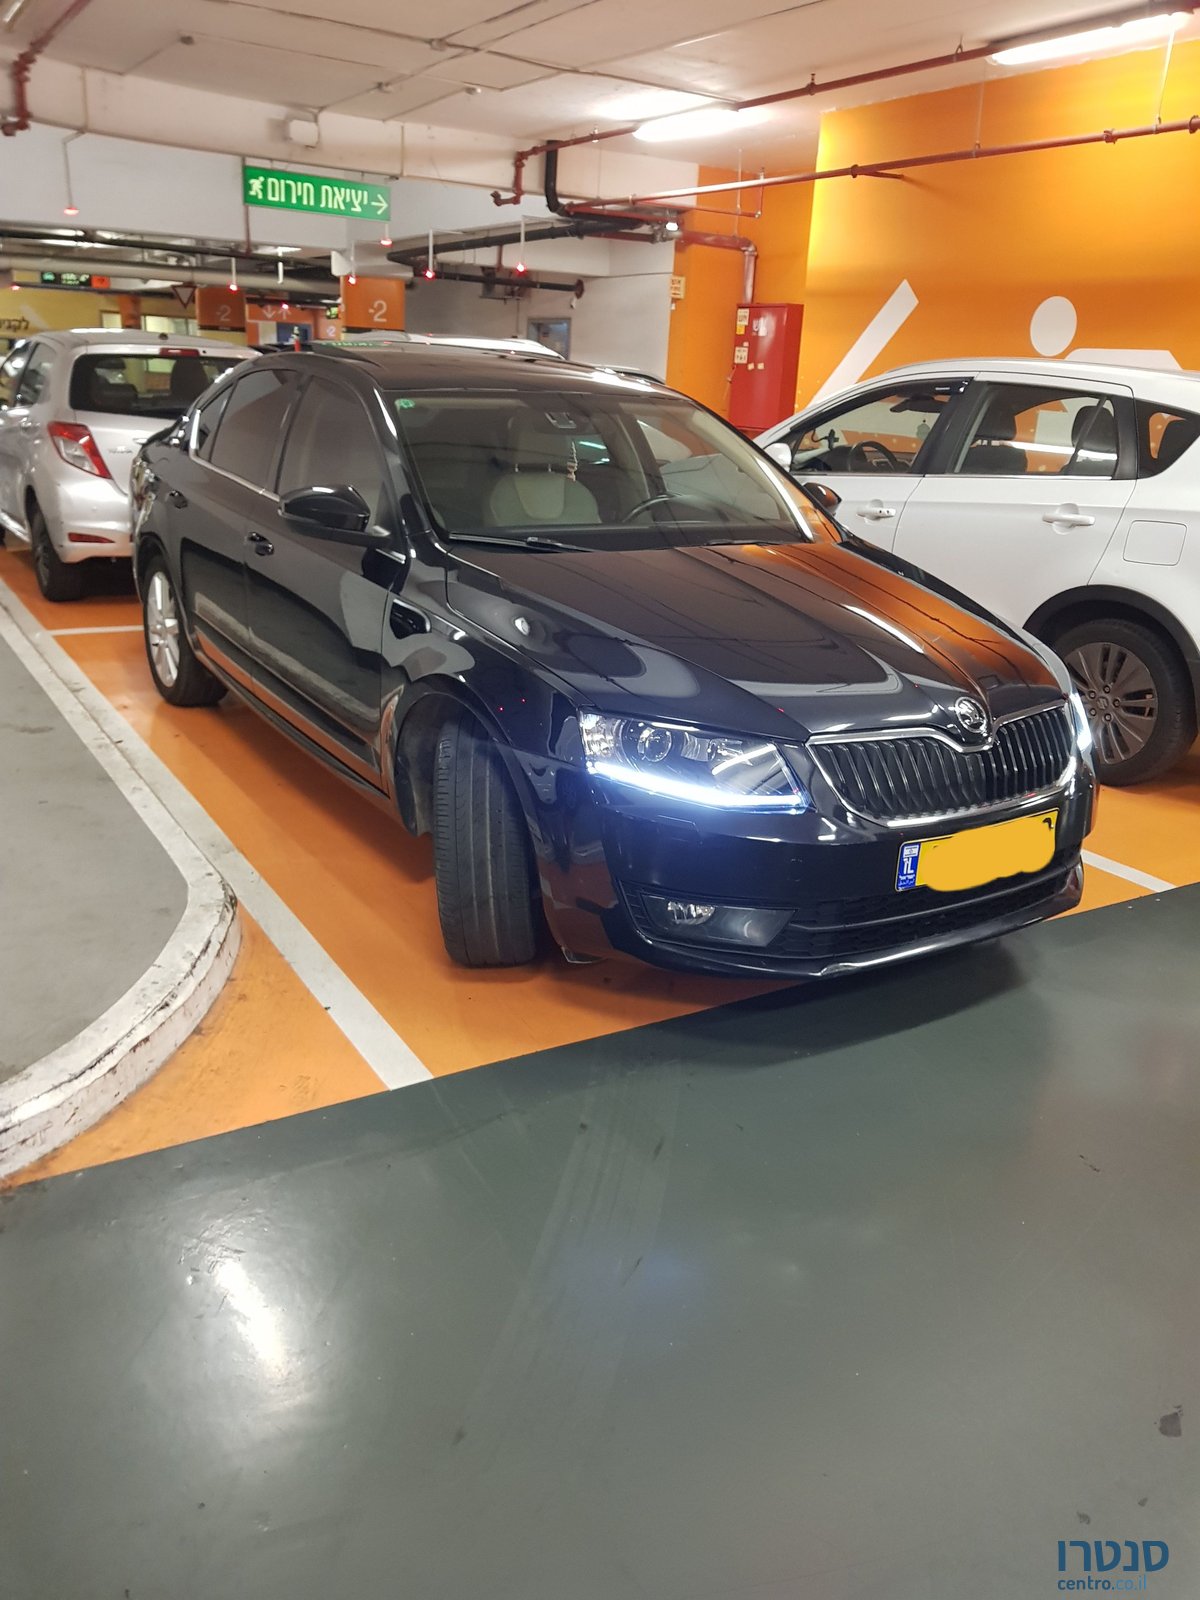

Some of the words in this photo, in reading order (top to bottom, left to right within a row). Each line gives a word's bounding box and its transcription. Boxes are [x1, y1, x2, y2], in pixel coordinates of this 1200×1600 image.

[266, 177, 315, 206] חירום
[320, 185, 369, 212] יציאת
[215, 304, 231, 321] -2
[368, 300, 387, 322] -2
[903, 857, 915, 875] IL
